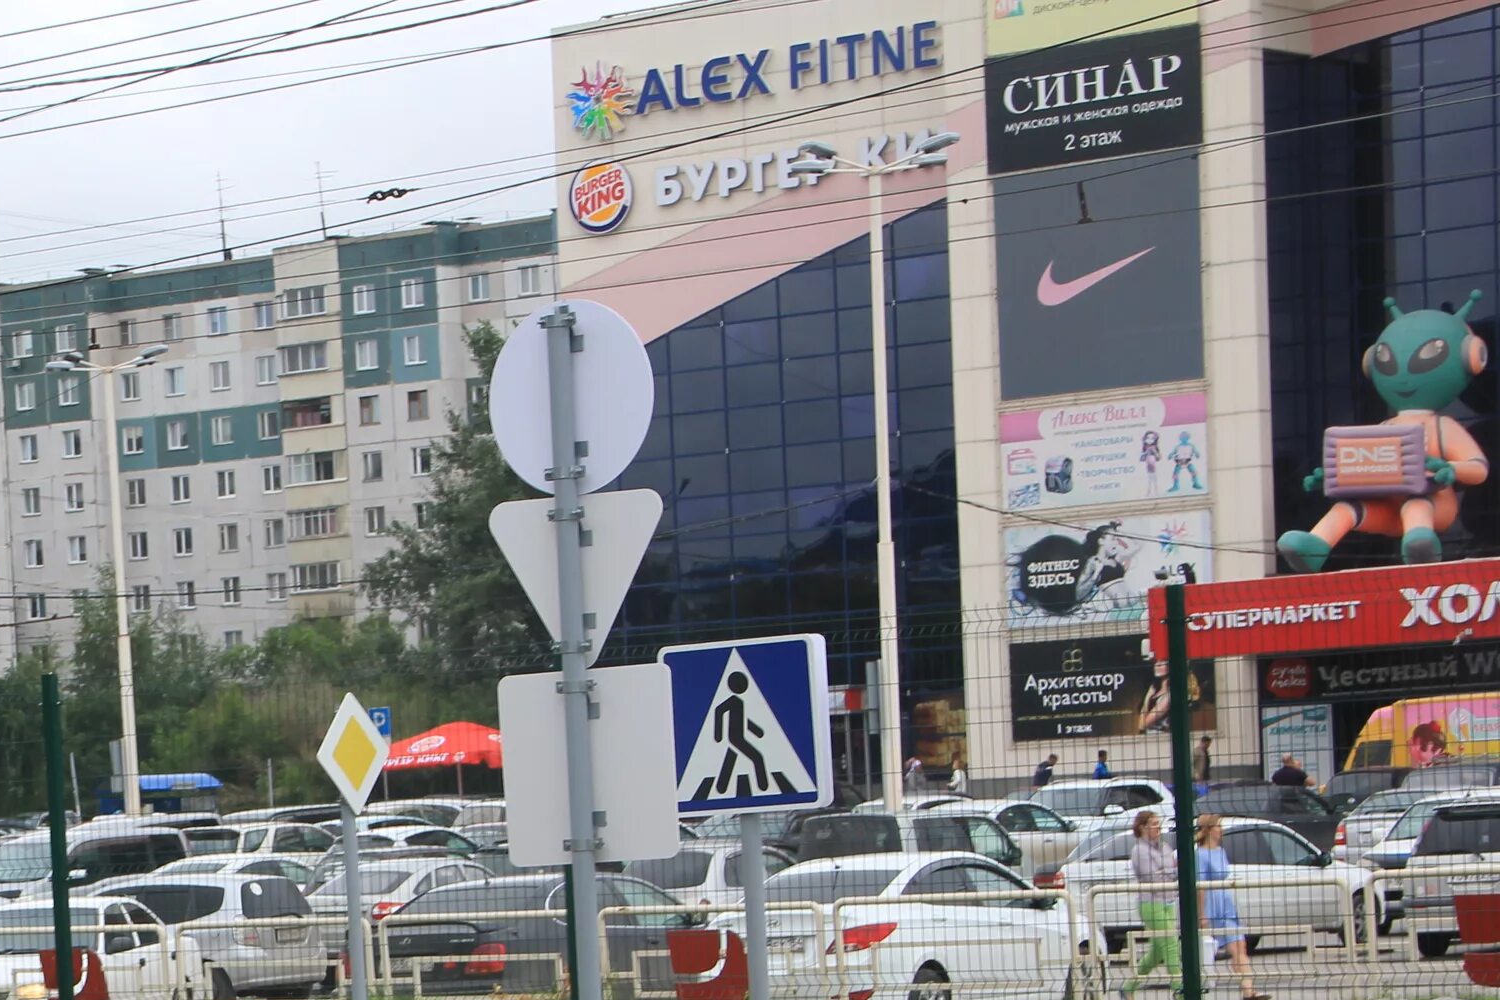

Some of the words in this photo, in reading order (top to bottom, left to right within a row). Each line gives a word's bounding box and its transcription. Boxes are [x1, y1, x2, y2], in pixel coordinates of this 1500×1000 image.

[635, 48, 771, 115] ALEX
[789, 20, 941, 90] FITNE
[1003, 54, 1182, 114] СИНАР
[1005, 115, 1059, 135] мужская
[1062, 113, 1071, 123] и
[1074, 104, 1129, 121] женская
[1132, 96, 1183, 114] одежда
[1064, 134, 1076, 150] 2
[1079, 129, 1122, 148] этаж
[574, 168, 623, 202] BURGER
[576, 183, 626, 222] KING
[1052, 408, 1098, 429] Алекс
[1102, 404, 1148, 423] Вилл
[1340, 446, 1397, 463] DNS
[1027, 559, 1080, 574] ФИТНЕС
[1027, 573, 1076, 588] ЗДЕСЬ
[1187, 601, 1361, 631] СУПЕРМАРКЕТ
[1024, 672, 1125, 695] Архитектор
[1318, 655, 1458, 690] Честный
[1043, 689, 1113, 711] красоты
[1065, 723, 1093, 734] этаж
